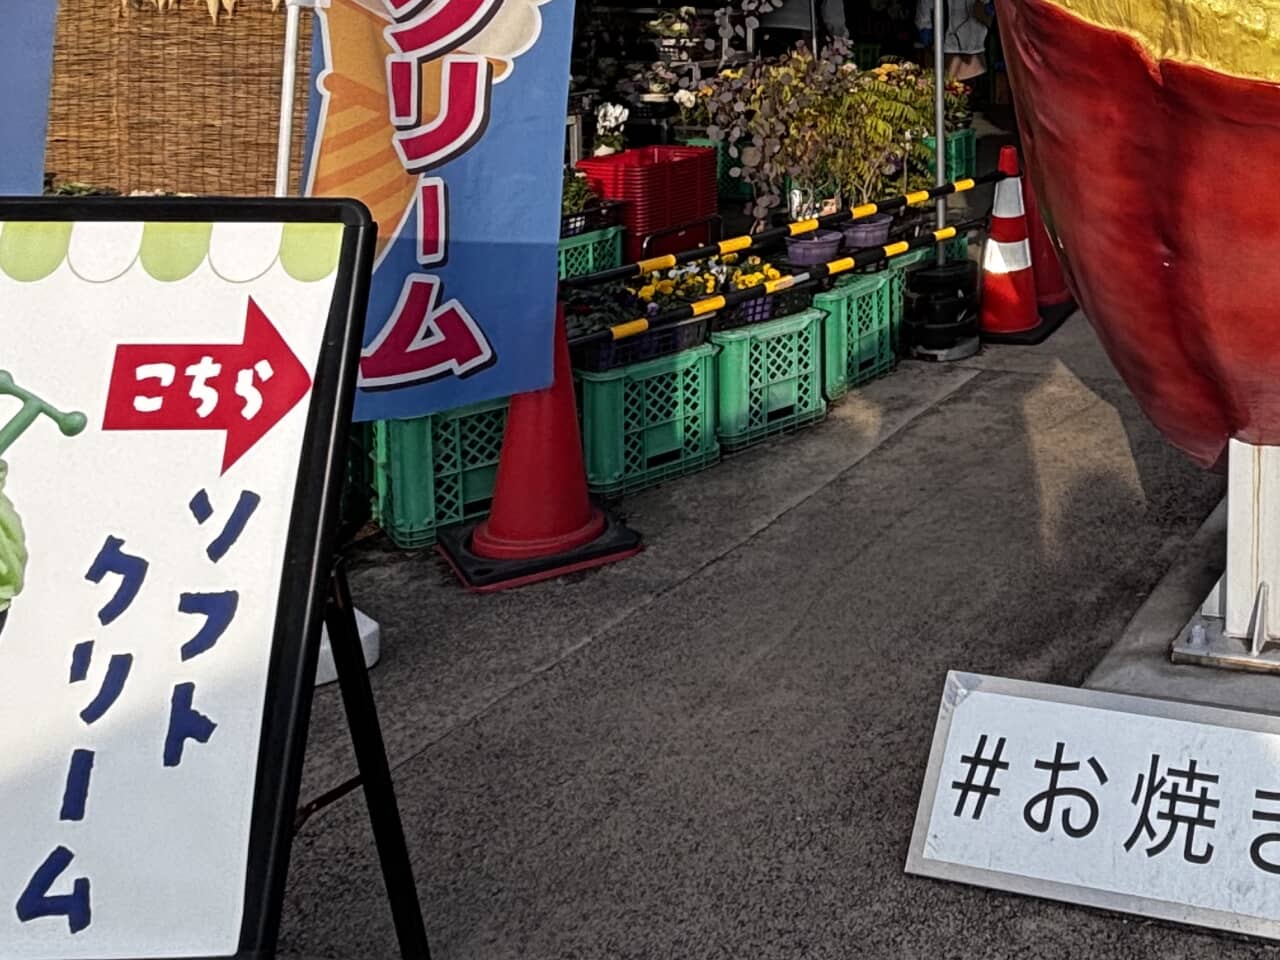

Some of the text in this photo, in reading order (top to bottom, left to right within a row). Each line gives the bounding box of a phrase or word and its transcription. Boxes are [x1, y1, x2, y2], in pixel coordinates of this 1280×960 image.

[132, 354, 275, 421] こちら
[15, 534, 150, 935] クリーム
[163, 488, 261, 768] ソフト
